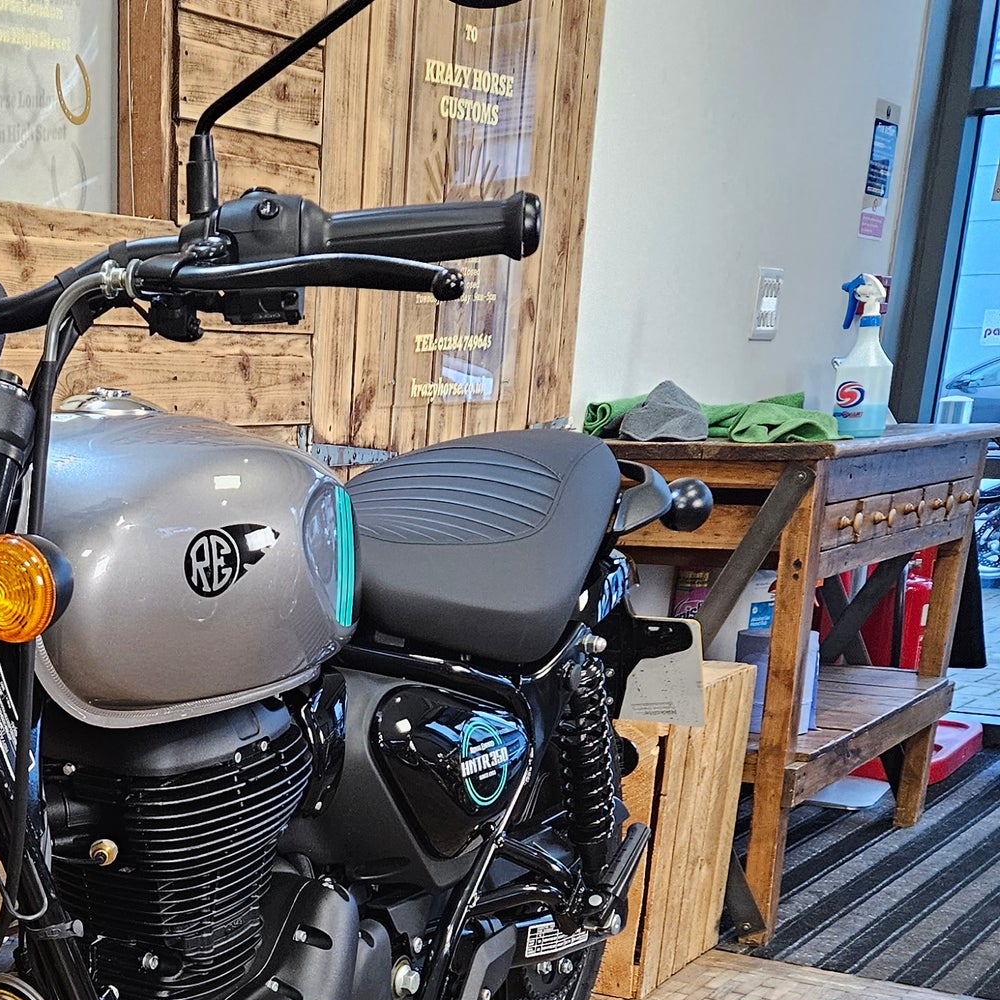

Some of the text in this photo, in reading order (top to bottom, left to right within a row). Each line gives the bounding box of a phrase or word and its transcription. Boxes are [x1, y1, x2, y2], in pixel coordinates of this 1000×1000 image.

[465, 24, 478, 42] TO
[425, 59, 514, 97] KRAZY HORSE
[440, 96, 499, 126] CUSTOMS
